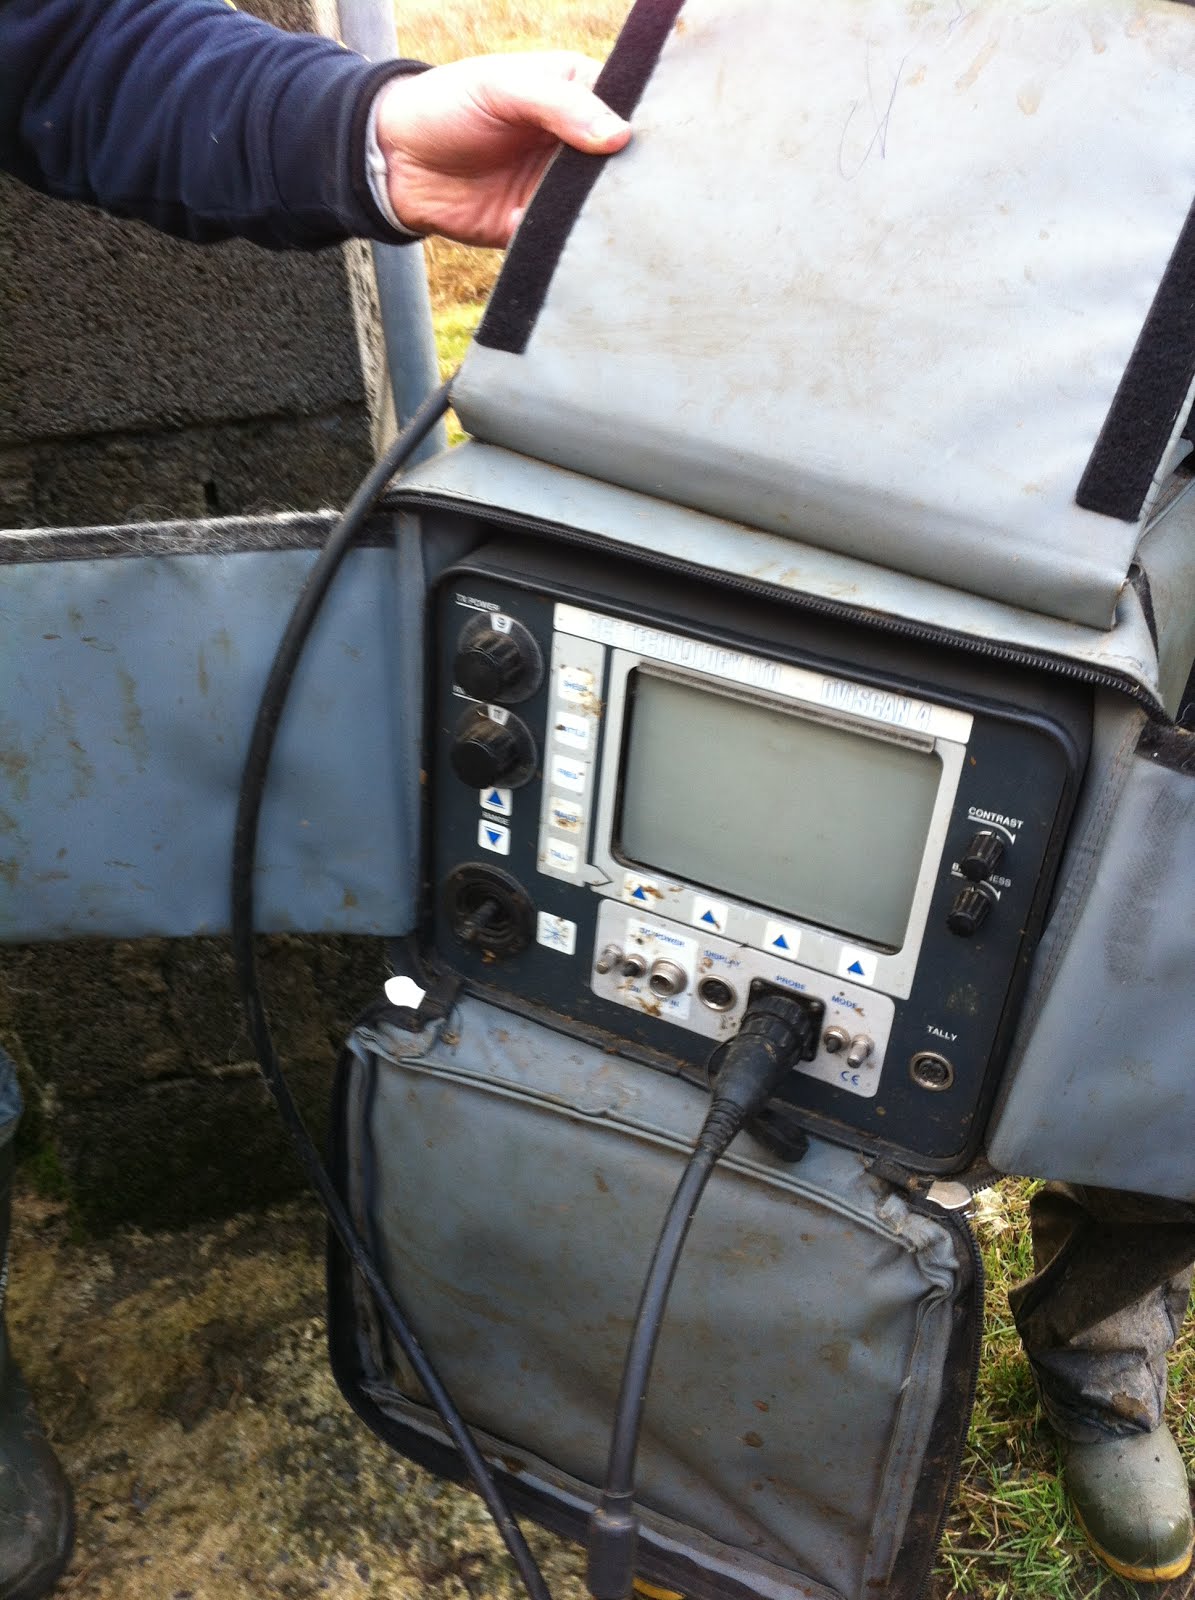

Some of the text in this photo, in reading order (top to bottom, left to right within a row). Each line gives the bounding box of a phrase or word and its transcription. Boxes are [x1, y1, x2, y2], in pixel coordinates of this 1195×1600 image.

[482, 811, 510, 826] RANGE
[968, 806, 1024, 829] CONTRAST
[776, 974, 808, 991] PROBE
[832, 995, 859, 1009] MODE
[926, 1024, 958, 1042] TALLY
[840, 1070, 861, 1086] CE
